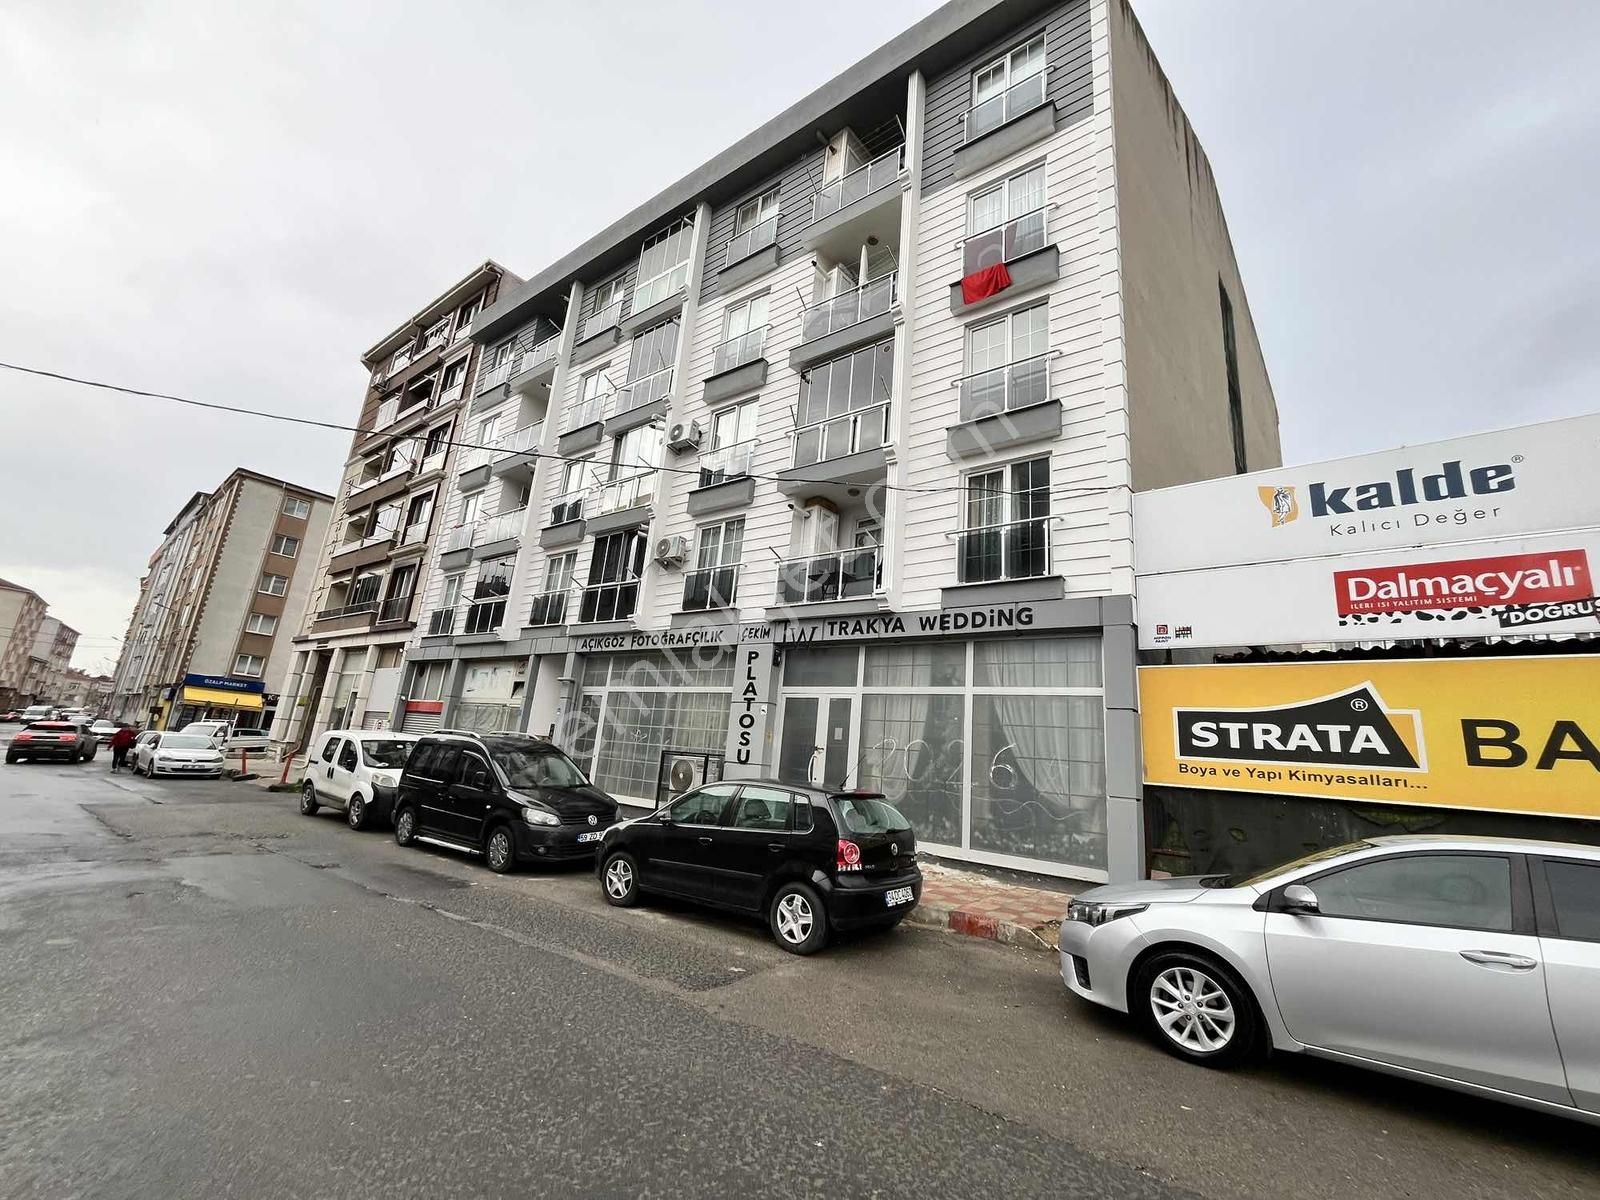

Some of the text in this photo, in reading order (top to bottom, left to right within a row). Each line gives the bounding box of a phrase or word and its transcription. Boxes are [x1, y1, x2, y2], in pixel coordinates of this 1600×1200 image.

[1308, 460, 1516, 518] kalde
[1329, 505, 1502, 538] Kalıcı Değer
[1347, 559, 1577, 601] Dalmaçyalı
[1377, 599, 1391, 608] ISI
[1392, 597, 1433, 608] YALITIM
[631, 629, 724, 651] FOTOĞRAFÇILIK
[741, 625, 771, 643] ÇEKİM
[827, 616, 906, 637] TRAKYA
[736, 650, 760, 765] PLATOSU
[1191, 721, 1391, 756] STRATA
[1178, 763, 1218, 779] Boya
[1221, 768, 1241, 778] ve
[1245, 767, 1282, 782] Yapı
